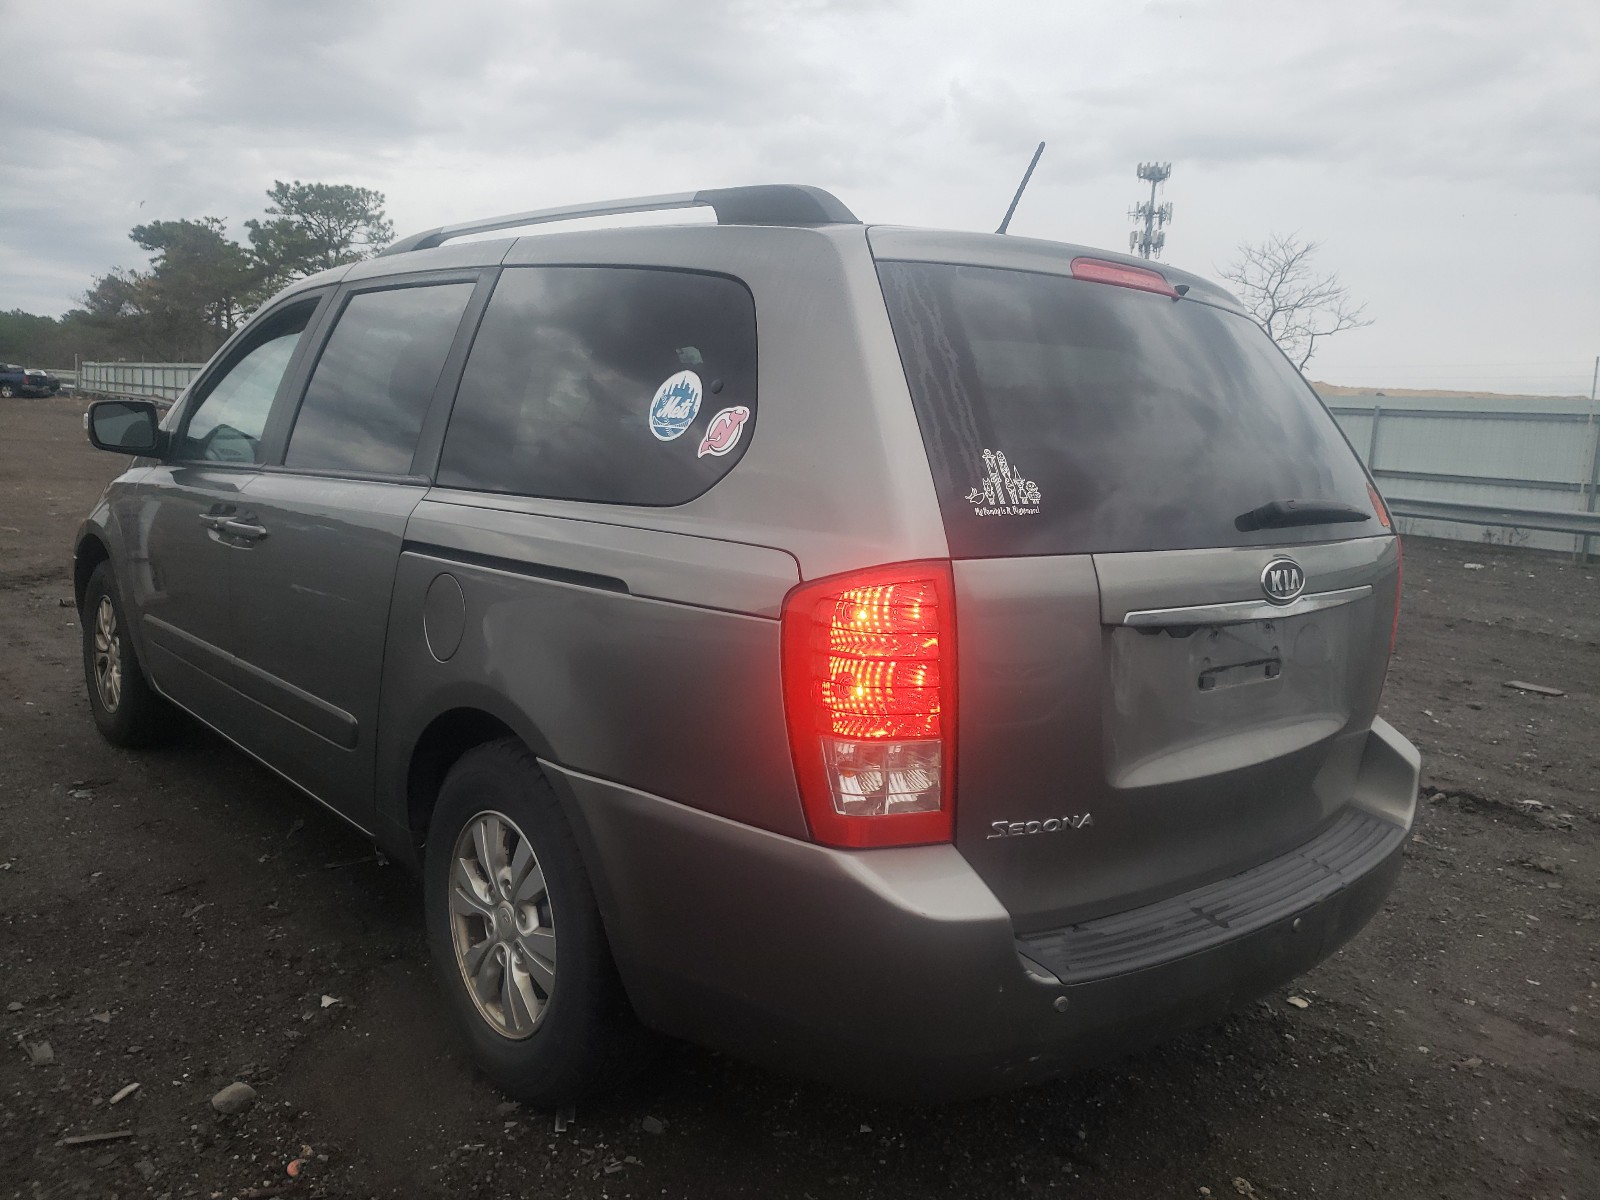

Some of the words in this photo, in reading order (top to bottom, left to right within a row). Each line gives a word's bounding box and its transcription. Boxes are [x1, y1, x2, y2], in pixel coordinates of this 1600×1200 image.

[656, 396, 693, 419] Mets
[1270, 568, 1301, 592] KIA
[986, 813, 1095, 840] SEDONA
